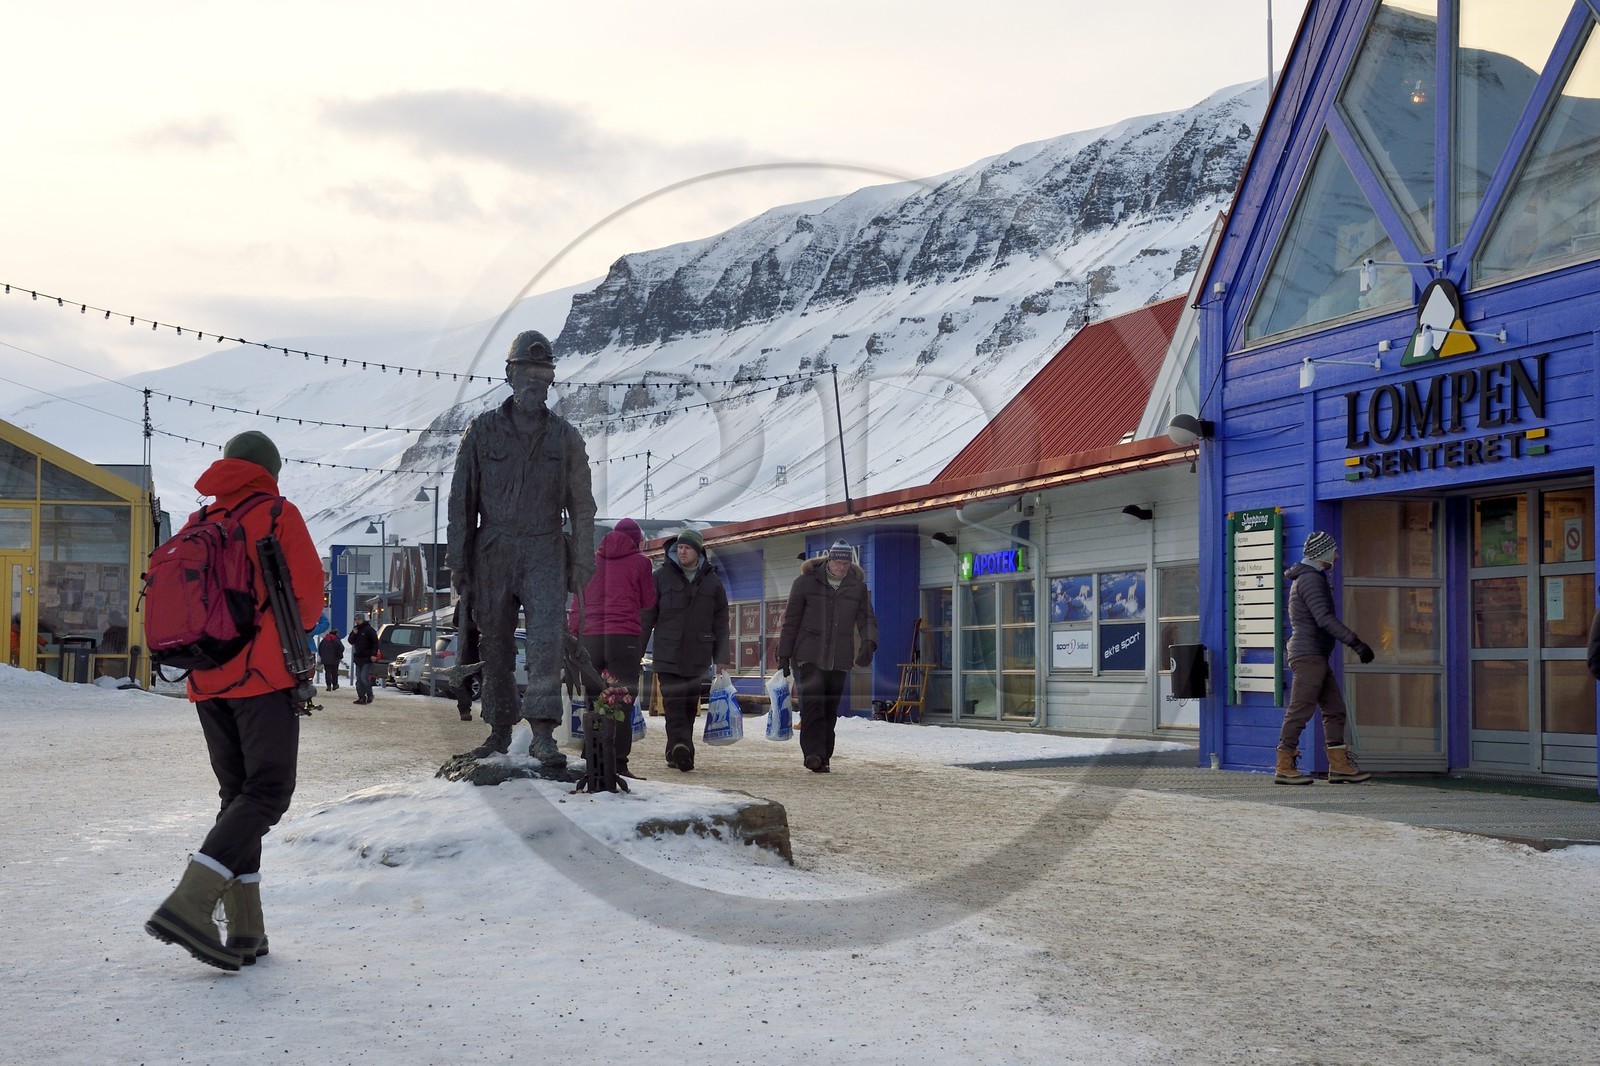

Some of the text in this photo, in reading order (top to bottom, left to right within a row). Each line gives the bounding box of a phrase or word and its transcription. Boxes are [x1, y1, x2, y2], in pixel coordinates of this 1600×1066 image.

[1344, 353, 1549, 450] LOMPEN
[1363, 432, 1526, 479] SENTERET
[1241, 512, 1269, 528] Shopping
[973, 548, 1025, 576] APOTEK 1
[1056, 643, 1070, 652] sport
[1104, 631, 1140, 659] ekte sport
